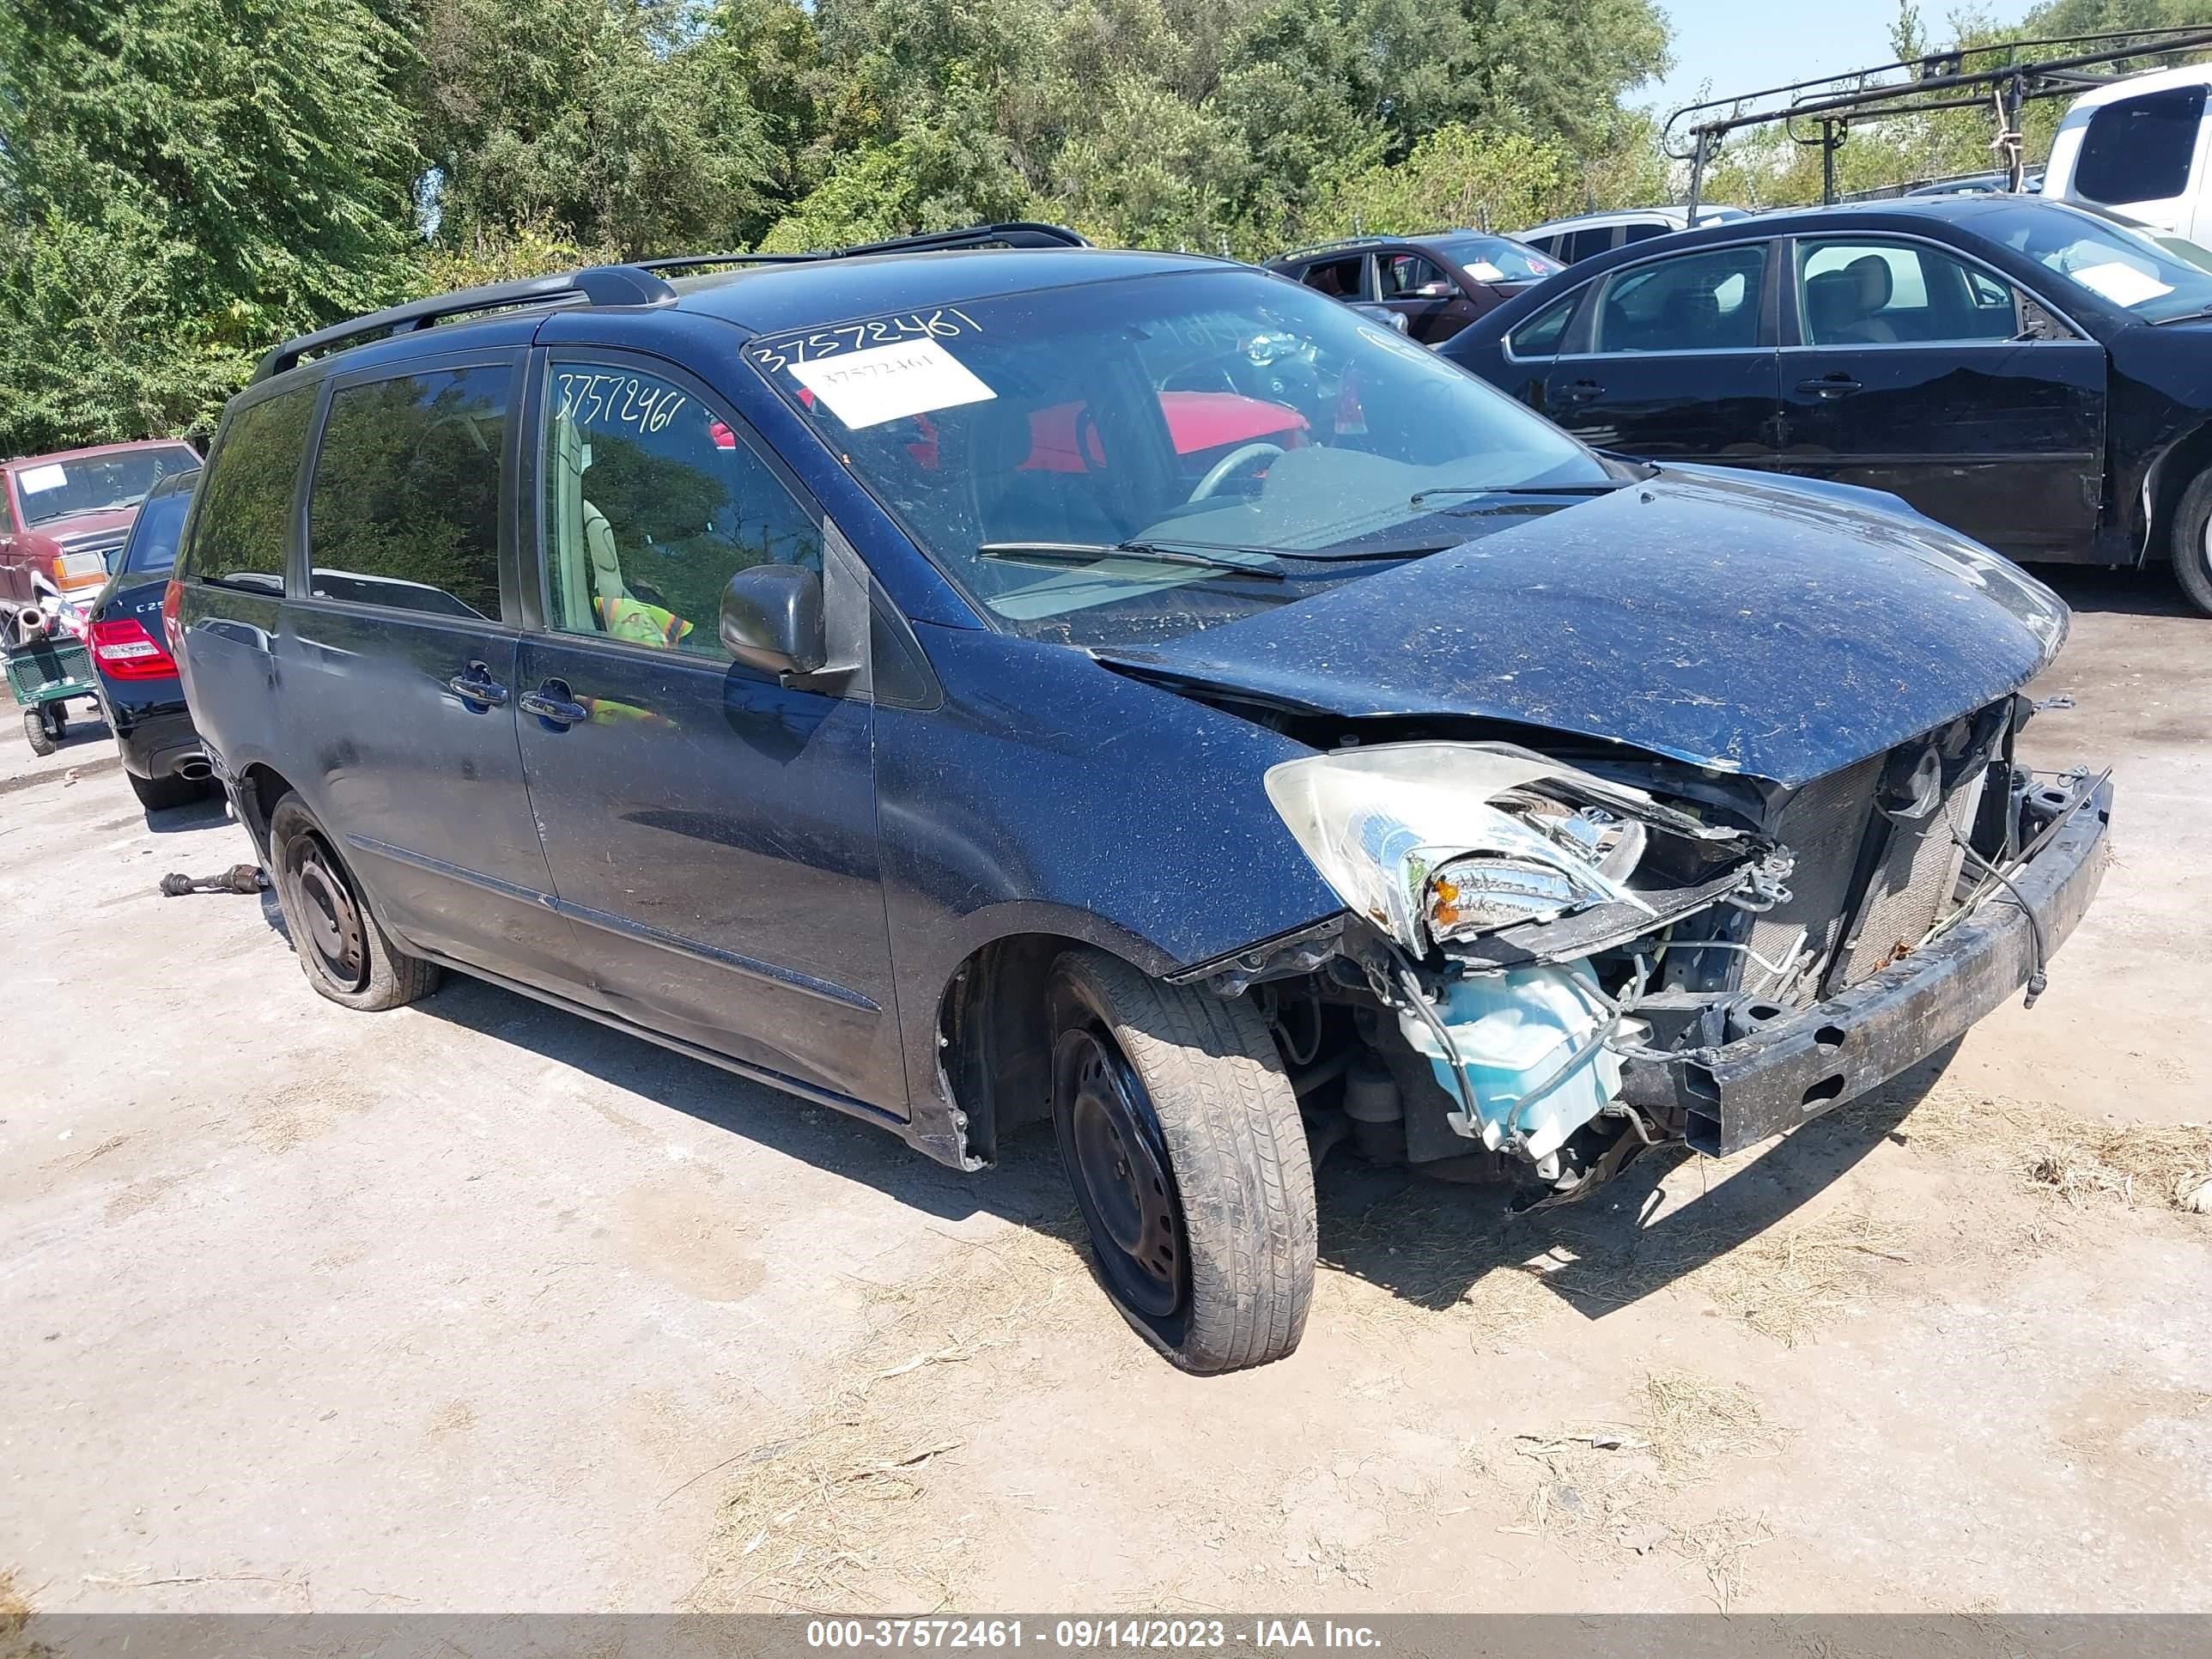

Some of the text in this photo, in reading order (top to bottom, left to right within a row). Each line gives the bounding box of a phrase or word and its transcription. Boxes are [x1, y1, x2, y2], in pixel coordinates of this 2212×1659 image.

[751, 308, 983, 373] 37572461
[555, 373, 686, 434] 37572461
[147, 600, 165, 611] 25
